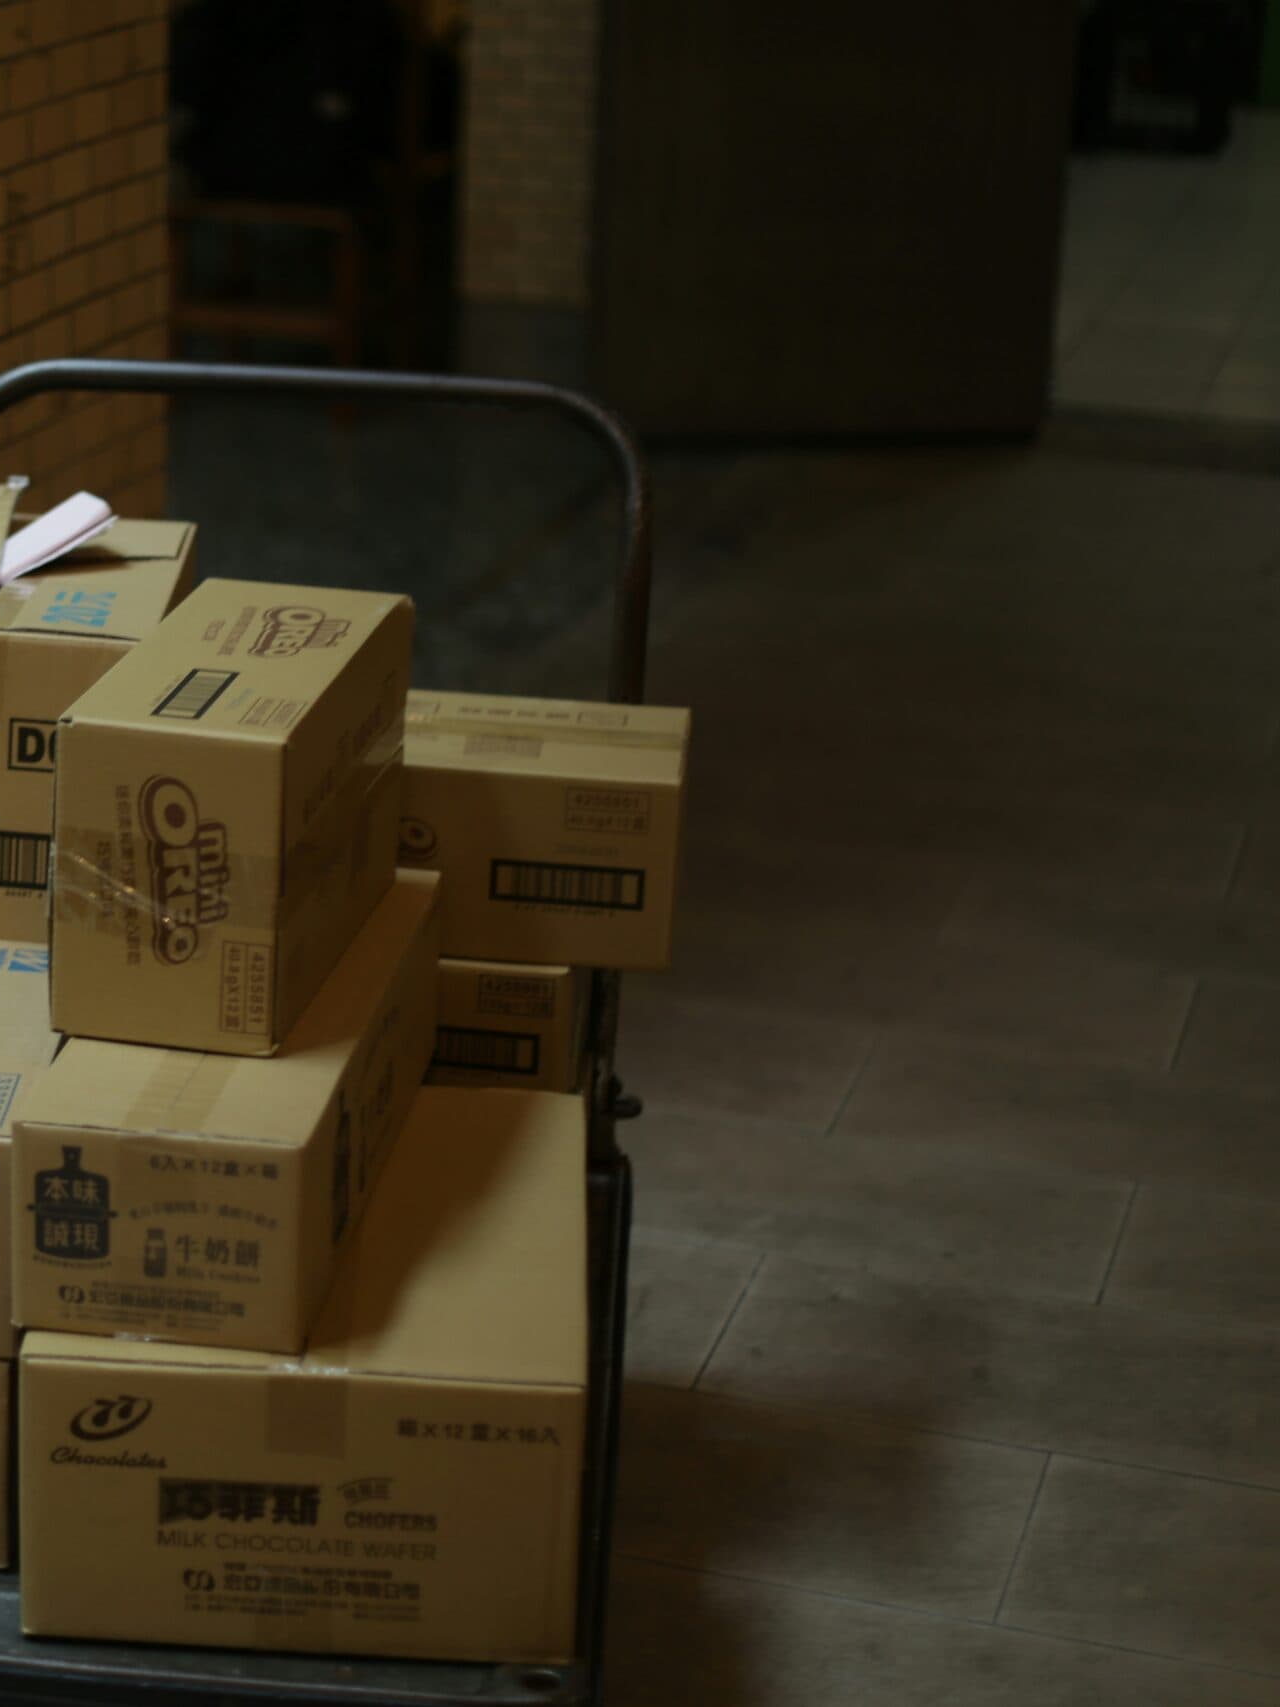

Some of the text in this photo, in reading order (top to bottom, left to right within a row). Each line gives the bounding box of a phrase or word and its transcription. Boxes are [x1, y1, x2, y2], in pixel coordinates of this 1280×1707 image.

[51, 1445, 167, 1470] Chocolates
[156, 1530, 438, 1563] MILK CHOCOLATE WAFER
